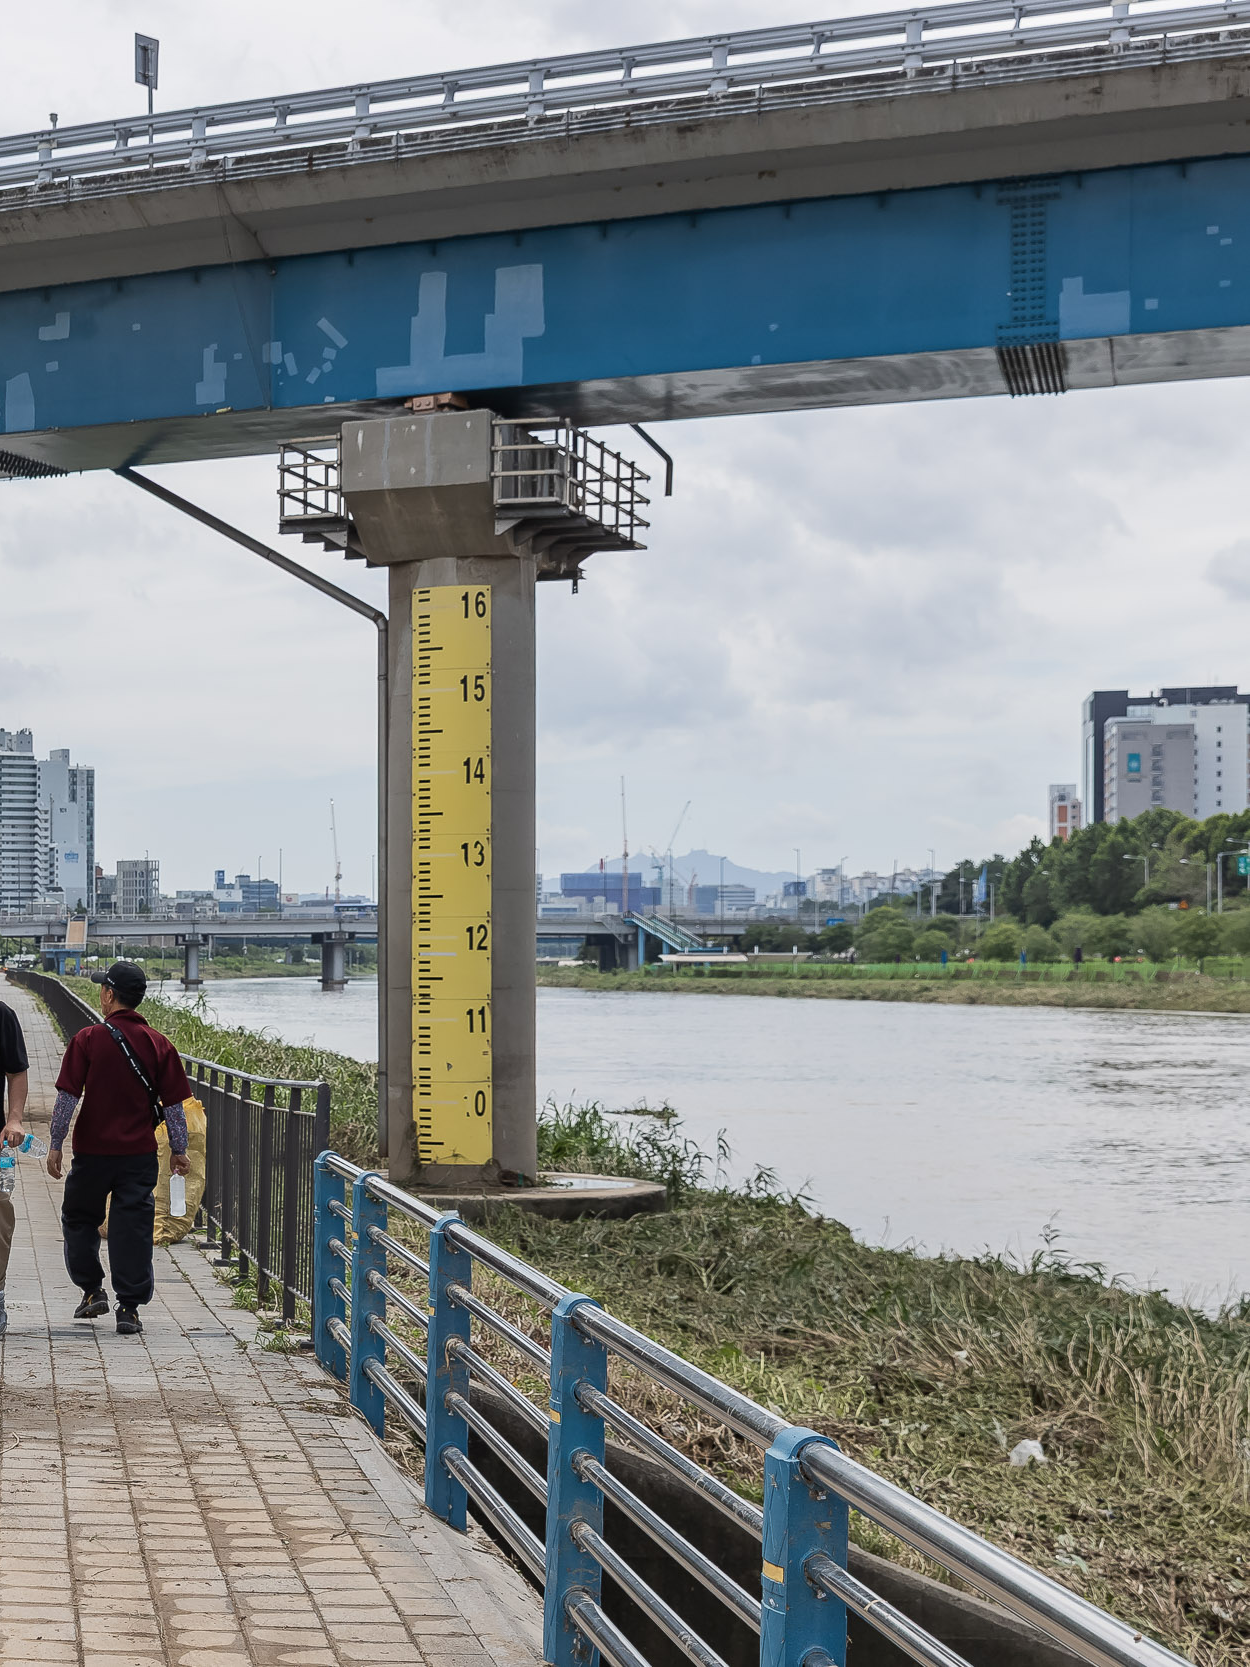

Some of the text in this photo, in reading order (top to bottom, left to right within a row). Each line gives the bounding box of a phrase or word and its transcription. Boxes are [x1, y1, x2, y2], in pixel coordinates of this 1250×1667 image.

[461, 591, 486, 619] 16
[460, 674, 485, 702] 15
[463, 757, 485, 784] 14
[461, 840, 485, 867] 13
[465, 923, 488, 951] 12
[466, 1006, 486, 1033] 11
[463, 1090, 486, 1117] 0
